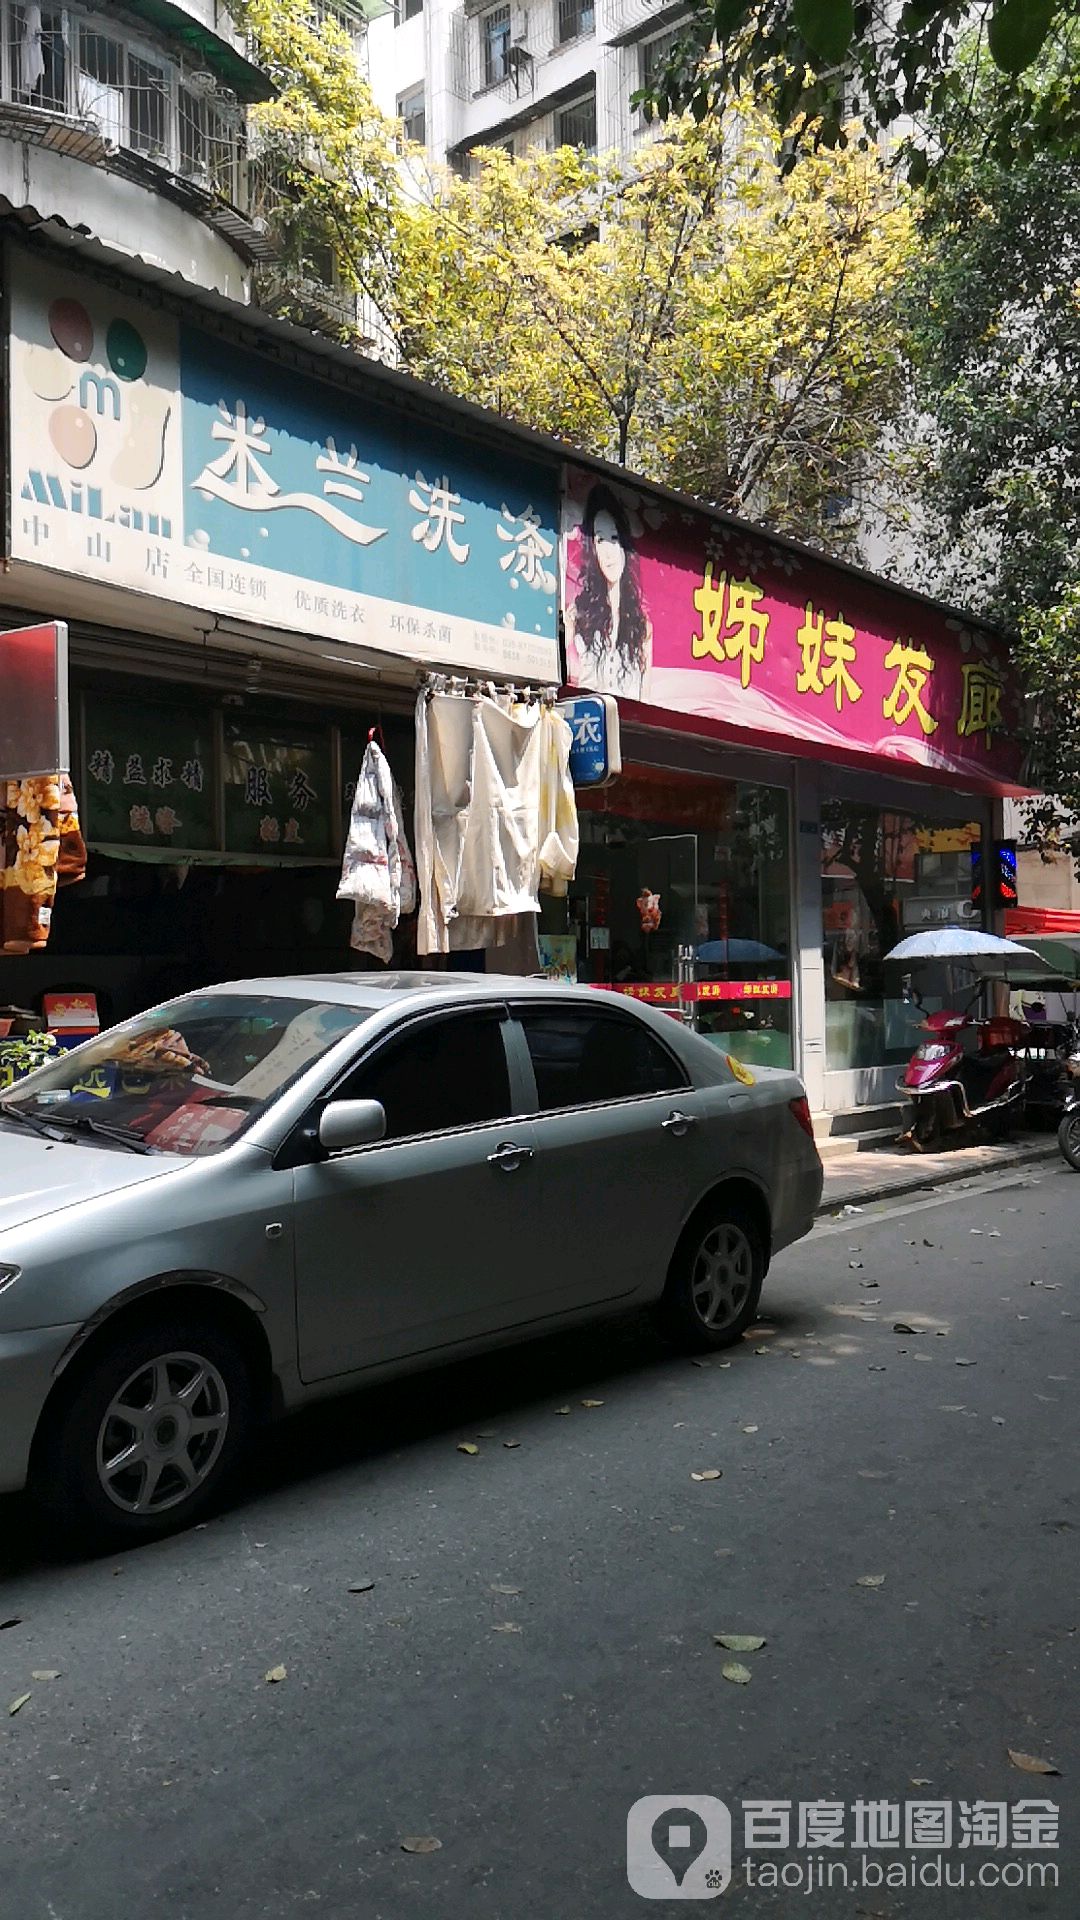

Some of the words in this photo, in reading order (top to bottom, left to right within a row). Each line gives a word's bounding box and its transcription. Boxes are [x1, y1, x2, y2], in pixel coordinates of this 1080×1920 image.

[190, 399, 555, 584] 米兰洗涤
[22, 514, 170, 579] 中山店
[184, 560, 267, 601] 全国连锁
[294, 588, 367, 625] 优质洗衣
[388, 614, 452, 643] 环保杀菌
[88, 750, 205, 792] 精益求精
[244, 764, 318, 812] 服务
